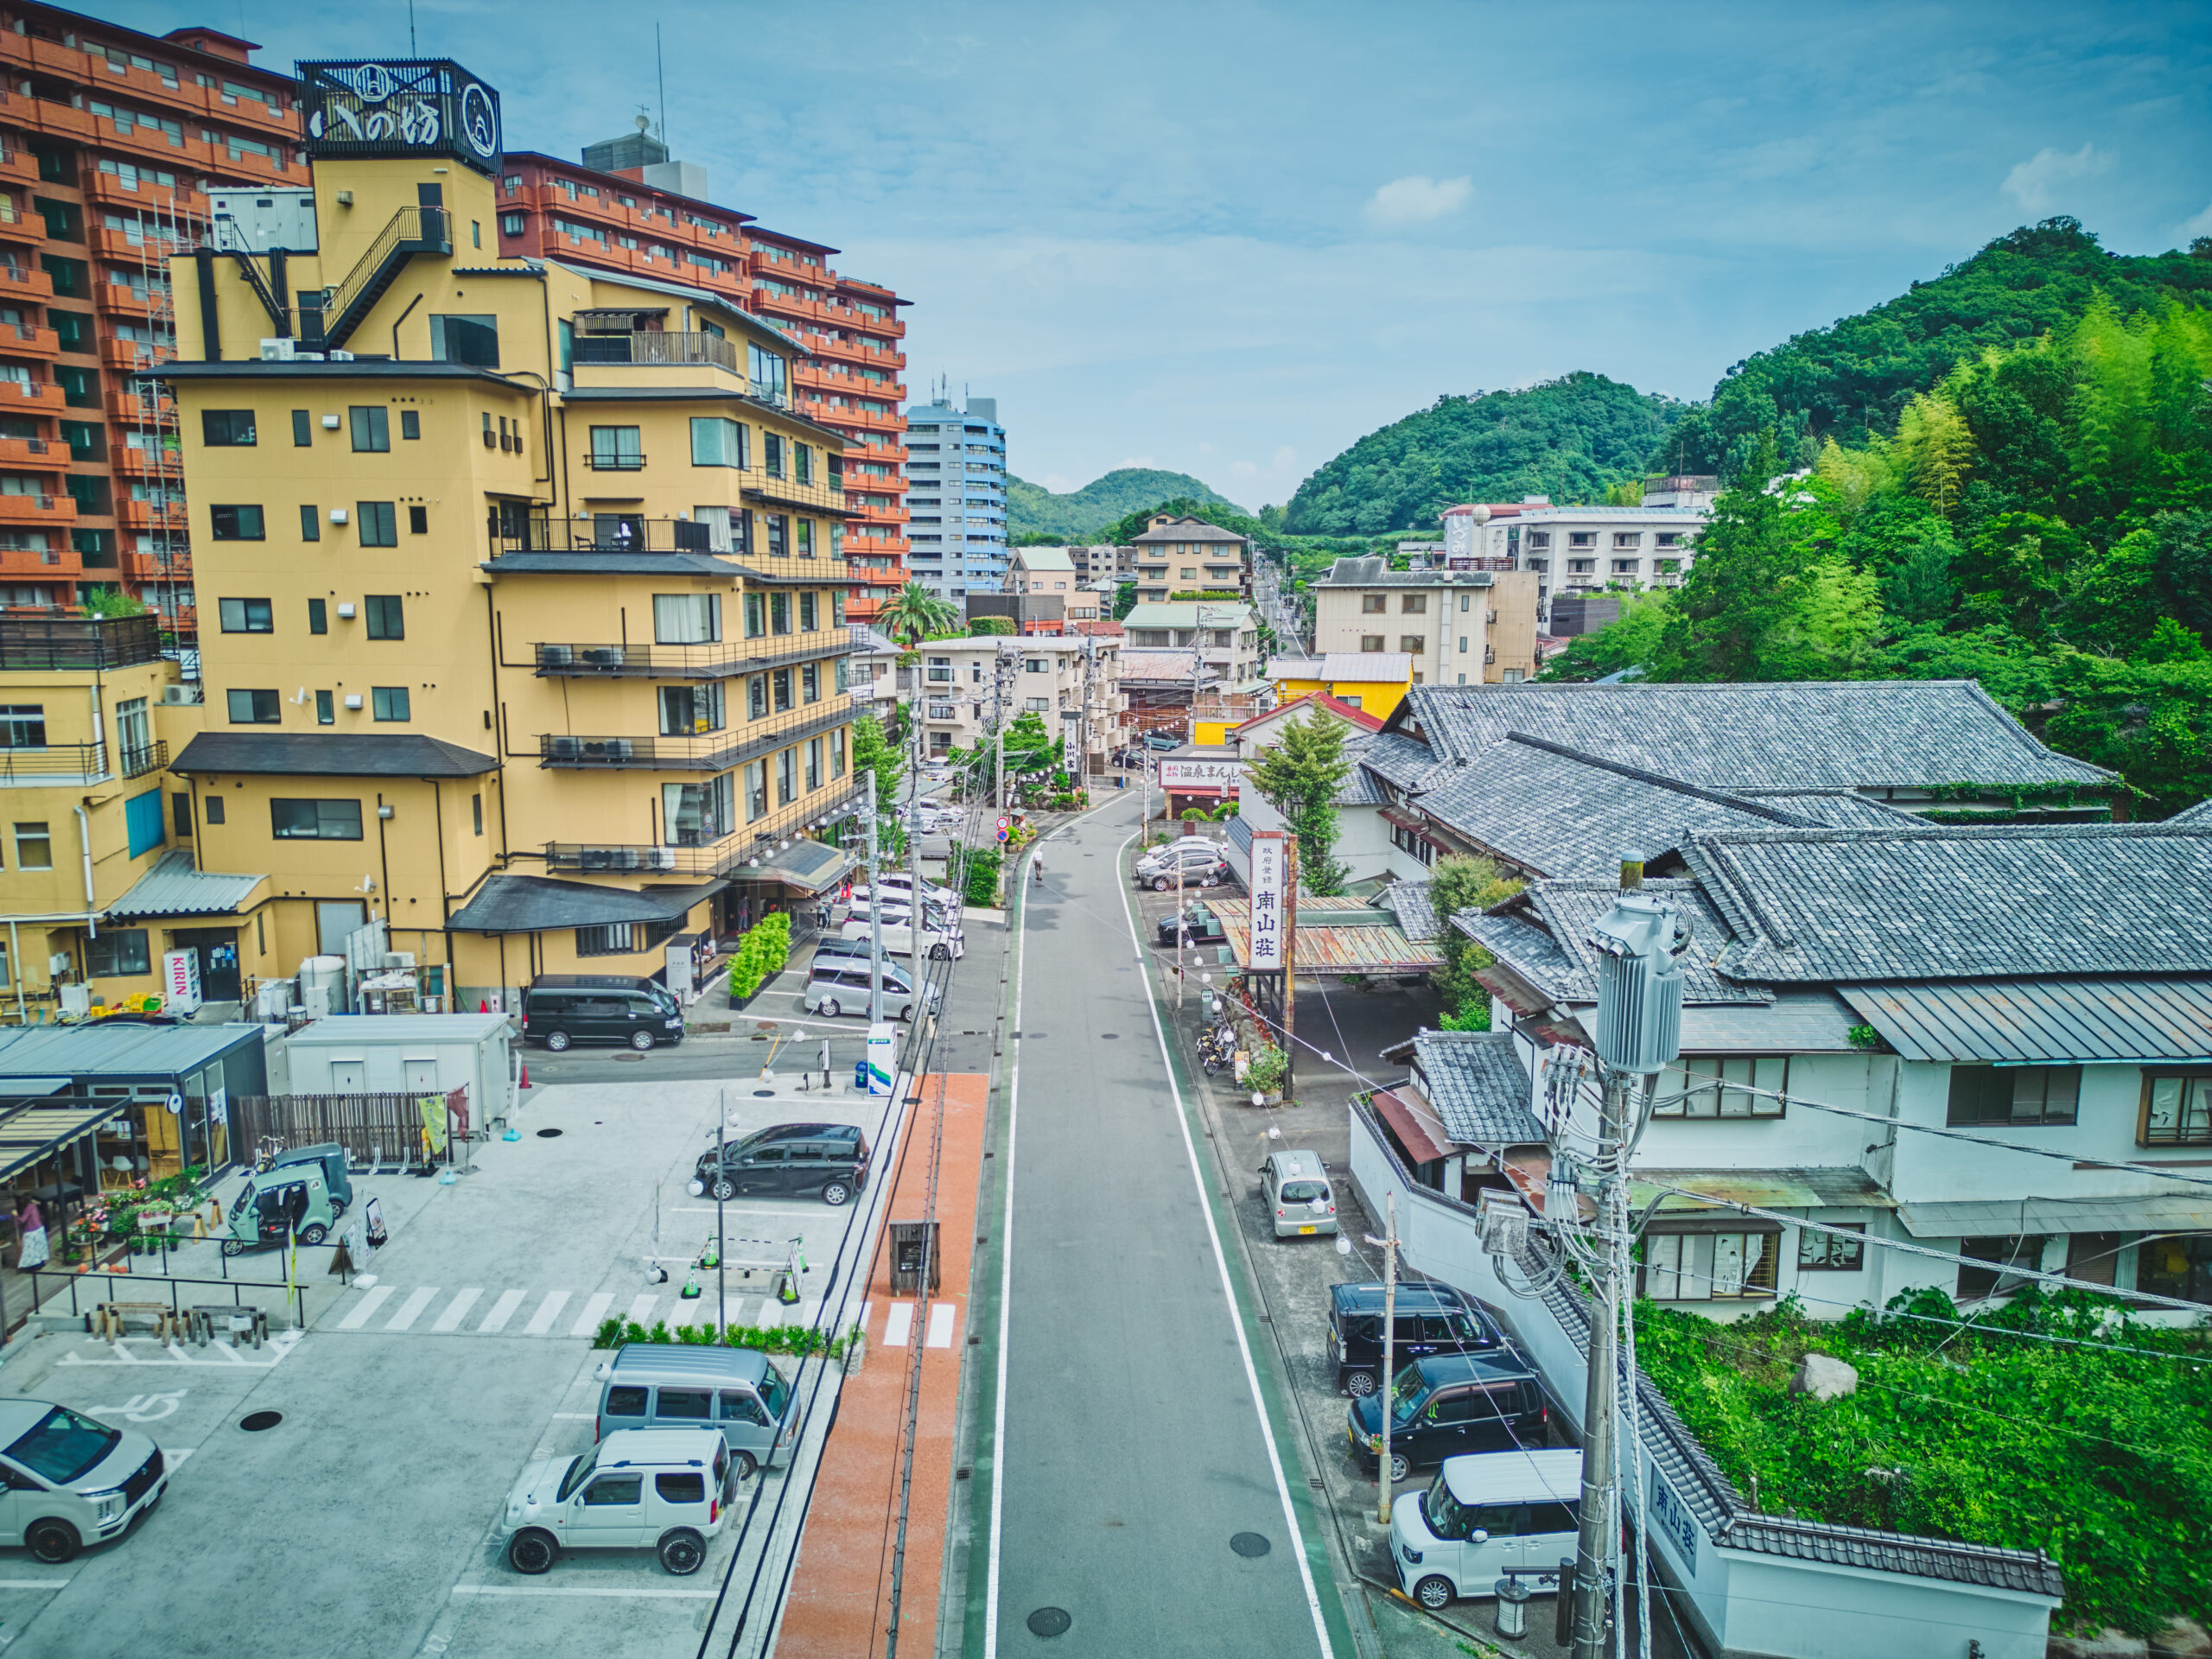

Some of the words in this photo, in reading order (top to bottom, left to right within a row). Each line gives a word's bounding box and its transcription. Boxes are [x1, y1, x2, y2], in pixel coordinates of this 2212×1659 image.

[309, 101, 440, 145] 八の坊
[1452, 512, 1469, 553] いづみ
[1065, 741, 1076, 769] 小川家
[1255, 890, 1275, 957] 南山荘
[172, 957, 188, 995] KIRIN
[1656, 1484, 1694, 1555] 南山荘
[423, 1634, 453, 1653] 22
